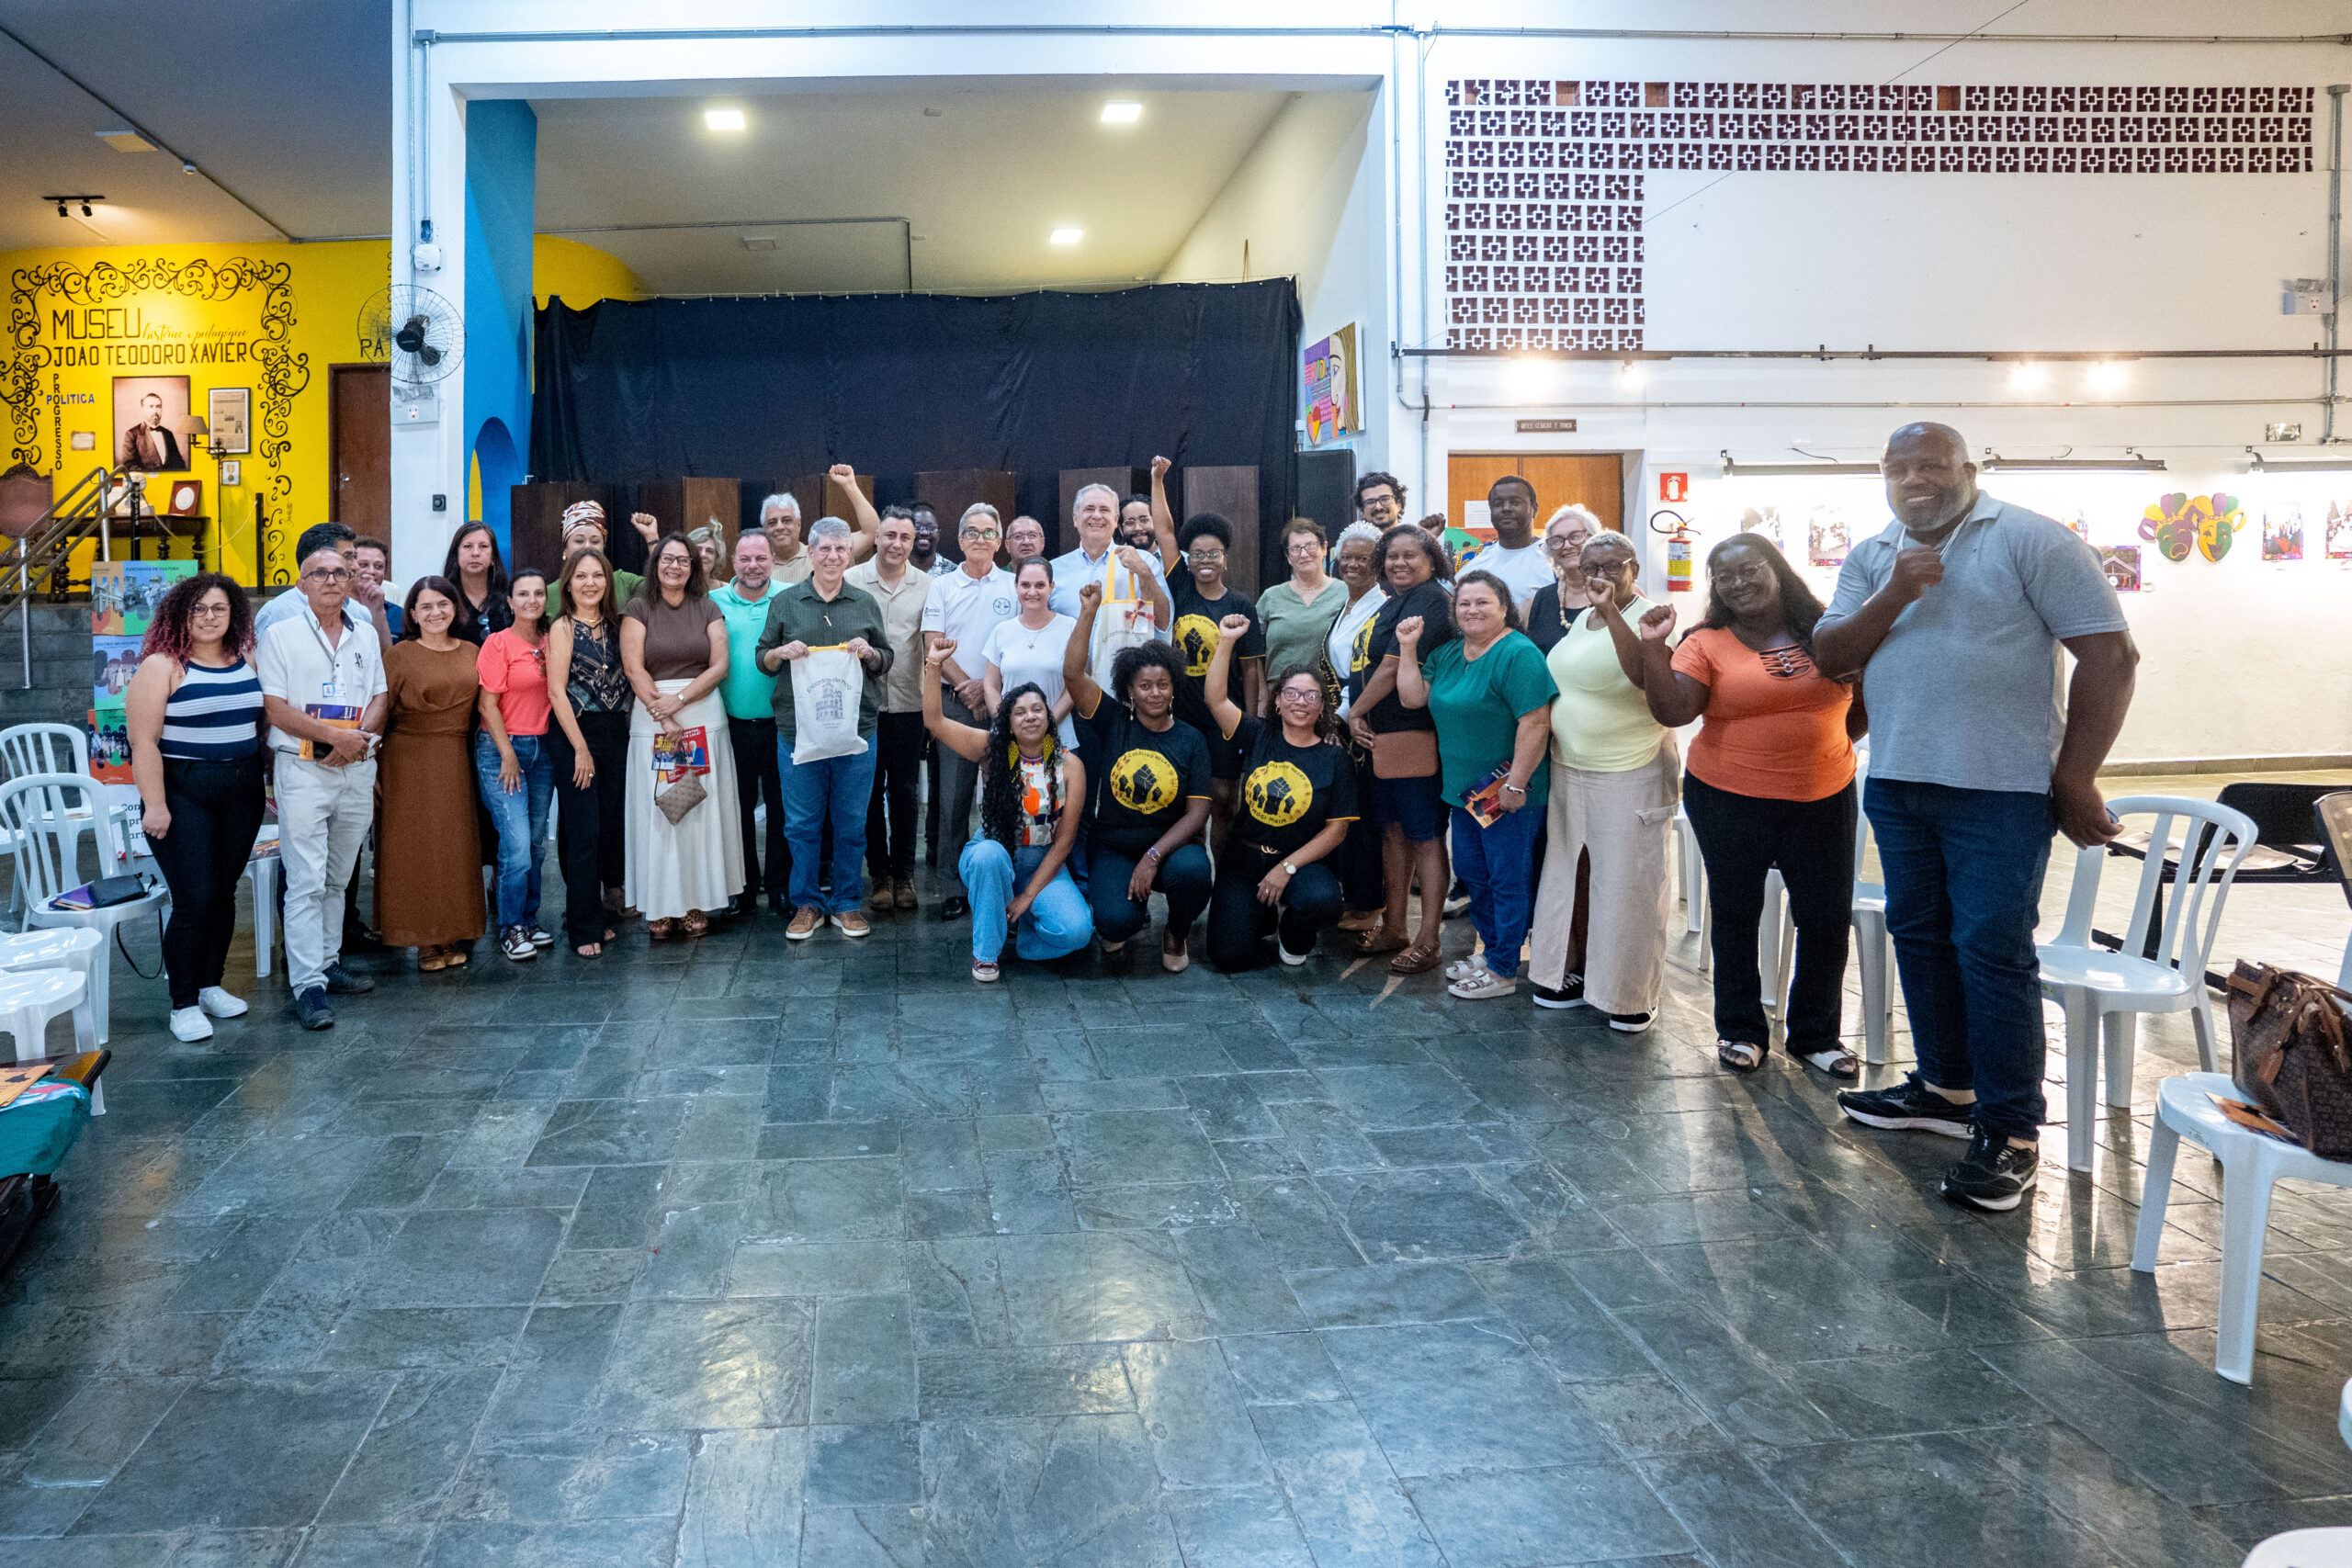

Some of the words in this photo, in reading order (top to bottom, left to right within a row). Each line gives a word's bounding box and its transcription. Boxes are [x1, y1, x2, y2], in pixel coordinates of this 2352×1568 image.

[52, 307, 141, 341] MUSEU
[53, 342, 99, 367] JOÃO
[104, 343, 186, 367] TEODORO
[189, 342, 247, 364] XAVIER
[52, 373, 62, 470] PROGRESSO
